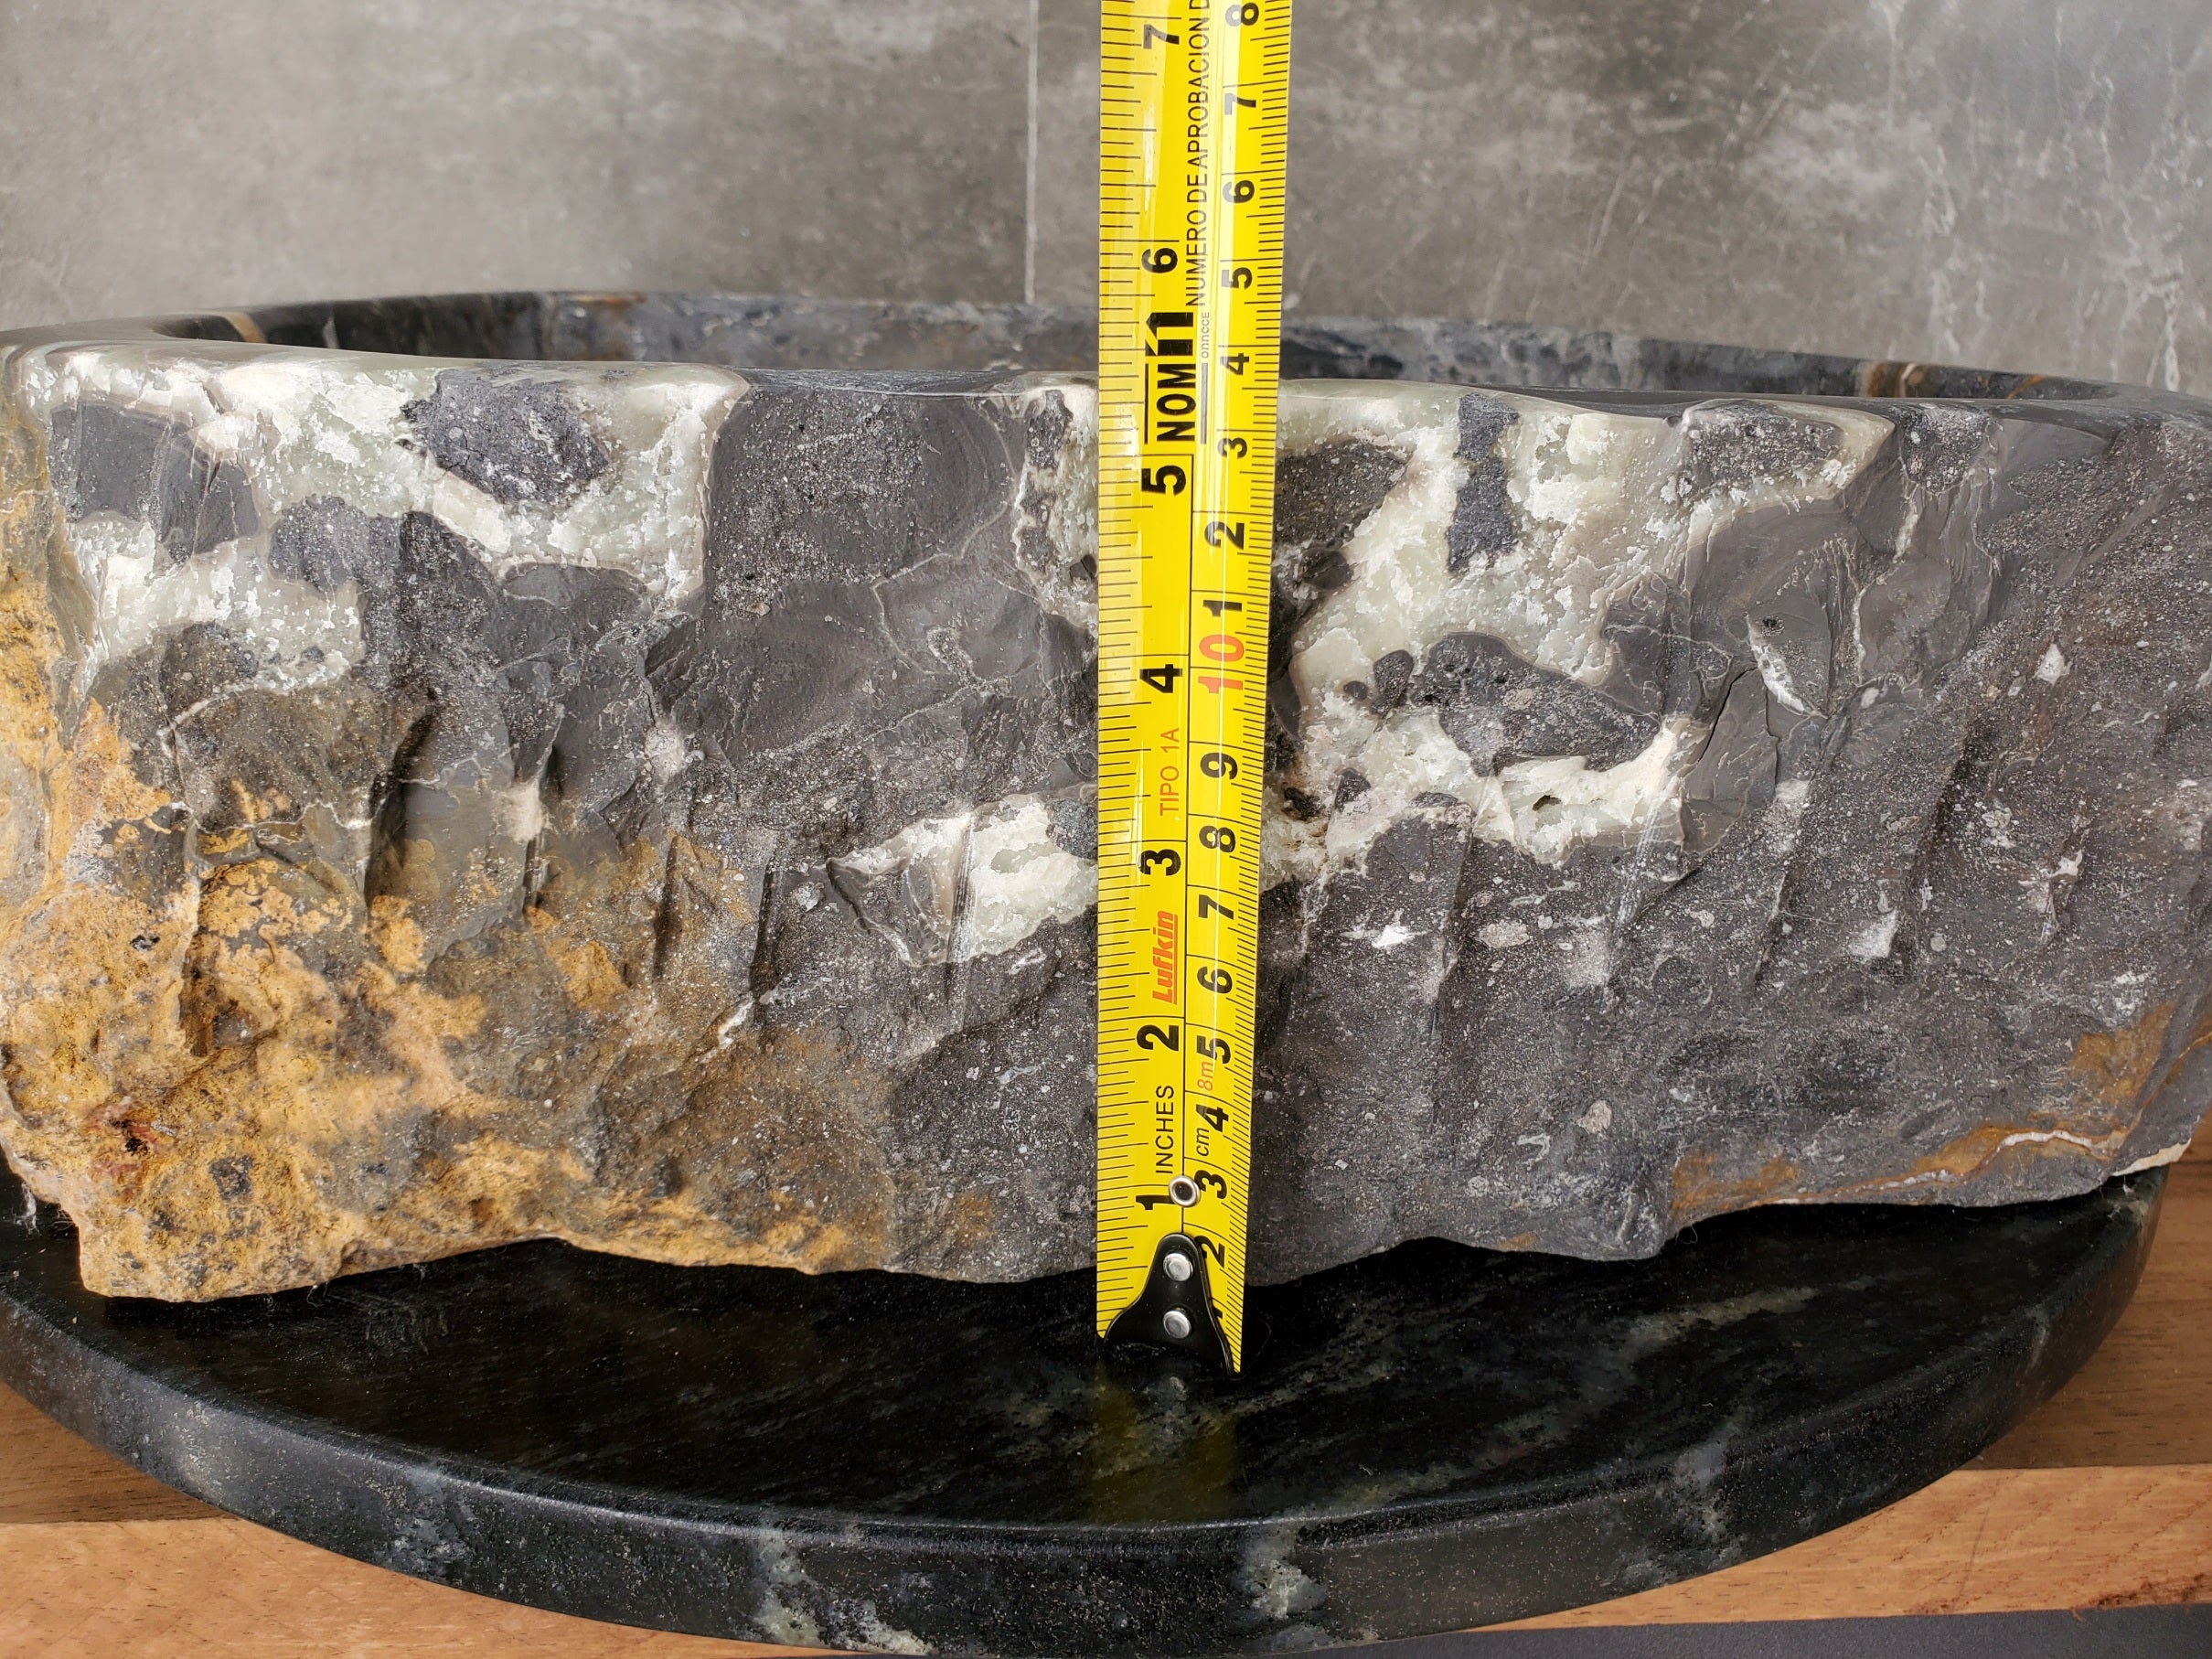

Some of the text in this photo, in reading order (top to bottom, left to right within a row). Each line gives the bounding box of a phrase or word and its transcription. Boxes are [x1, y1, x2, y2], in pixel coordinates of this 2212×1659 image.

[1225, 2, 1259, 27] 8
[1143, 24, 1180, 49] 7
[1188, 18, 1210, 169] APROBACION
[1224, 92, 1256, 115] 7
[1187, 174, 1208, 203] DE
[1223, 180, 1256, 204] 6
[1141, 247, 1178, 273] 6
[1186, 210, 1207, 306] NUMERO
[1221, 267, 1253, 290] 5
[1220, 353, 1250, 375] 4
[1156, 363, 1197, 442] NOM
[1217, 437, 1248, 459] 3
[1141, 465, 1187, 495] 5
[1204, 521, 1245, 549] 2
[1139, 663, 1182, 694] 4
[1159, 728, 1180, 816] TIPO 1A
[1200, 753, 1238, 780] 9
[1199, 825, 1236, 852] 8
[1138, 849, 1181, 876] 3
[1198, 894, 1234, 920] 7
[1152, 910, 1175, 1004] Lufkin
[1197, 967, 1233, 993] 6
[1136, 1024, 1180, 1052] 2
[1197, 1035, 1231, 1064] 5
[1197, 1061, 1213, 1091] 8m
[1156, 1086, 1174, 1174] INCHES
[1196, 1104, 1229, 1132] 4
[1196, 1127, 1209, 1157] cm
[1194, 1170, 1227, 1200] 3
[1194, 1236, 1225, 1268] 2
